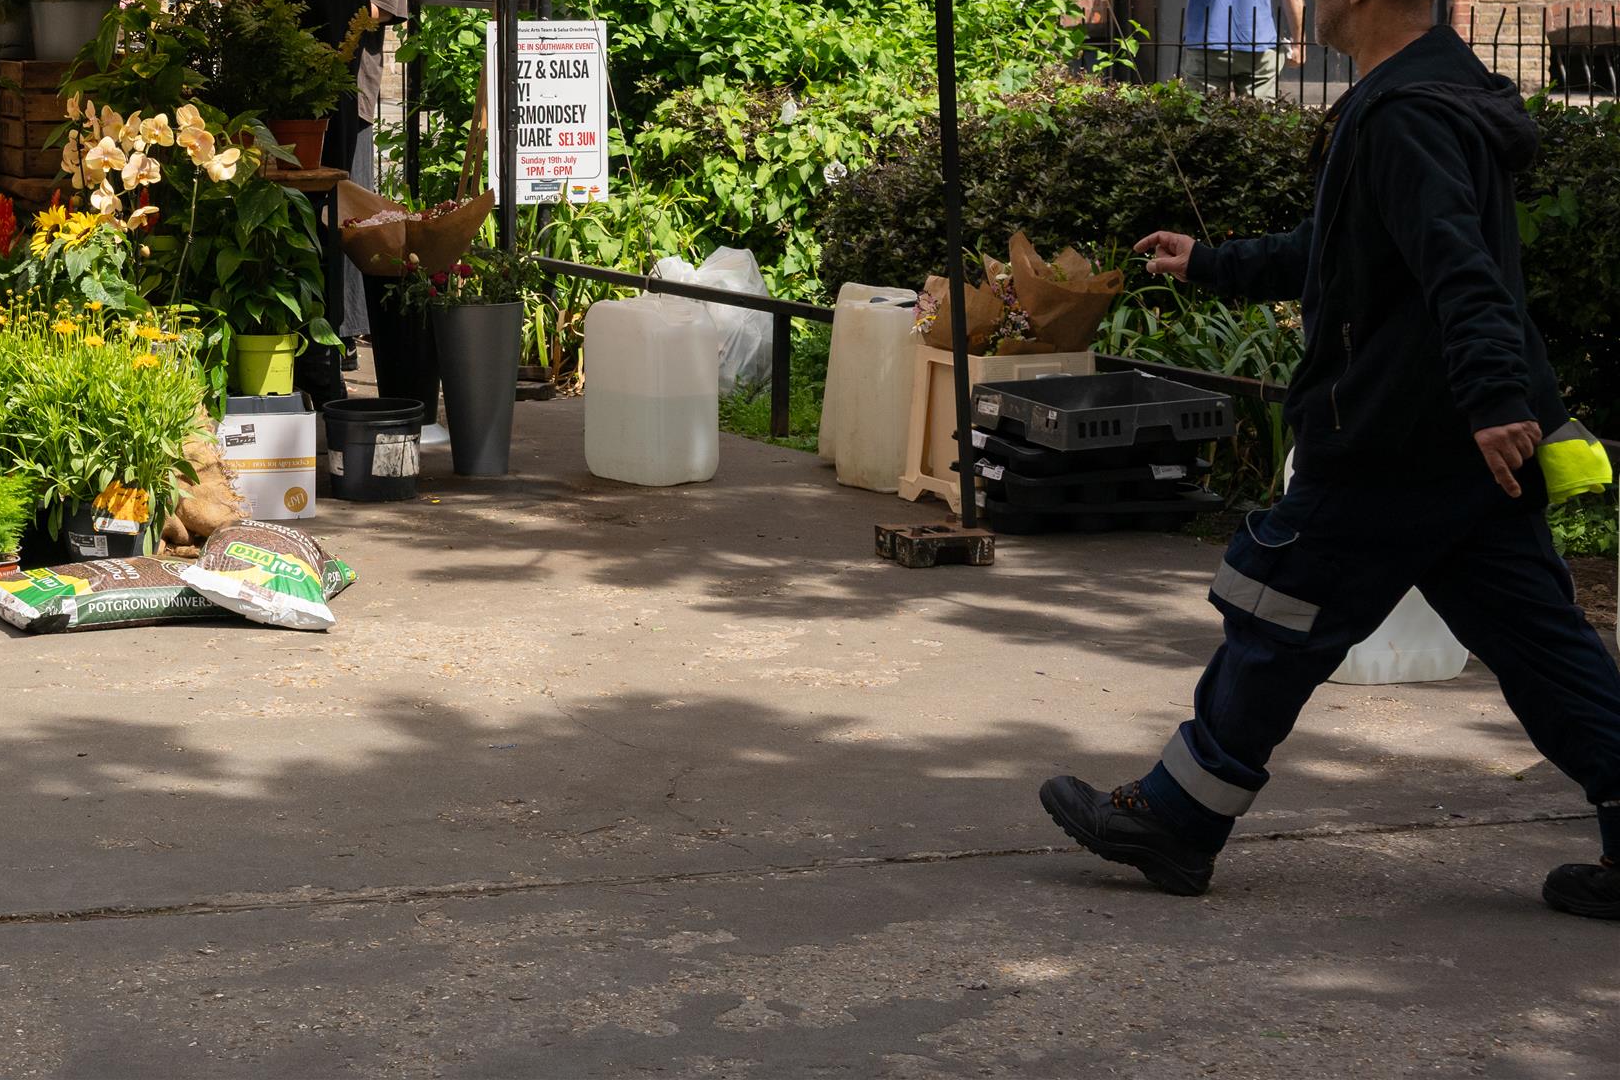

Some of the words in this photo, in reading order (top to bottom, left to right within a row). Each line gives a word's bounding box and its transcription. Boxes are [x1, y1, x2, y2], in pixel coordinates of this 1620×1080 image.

[527, 43, 534, 51] IN
[535, 43, 574, 51] SOUTHWARK
[575, 42, 594, 50] EVENT
[535, 60, 546, 79] &
[549, 59, 589, 79] SALSA
[518, 104, 587, 125] RMONDSEY
[558, 132, 574, 146] SE1
[577, 131, 596, 146] 3UN
[521, 156, 546, 165] Sunday
[548, 155, 562, 164] 19th
[563, 155, 577, 164] July
[526, 166, 545, 176] 1PM
[553, 165, 573, 176] 6PM
[88, 597, 159, 614] POTGROND
